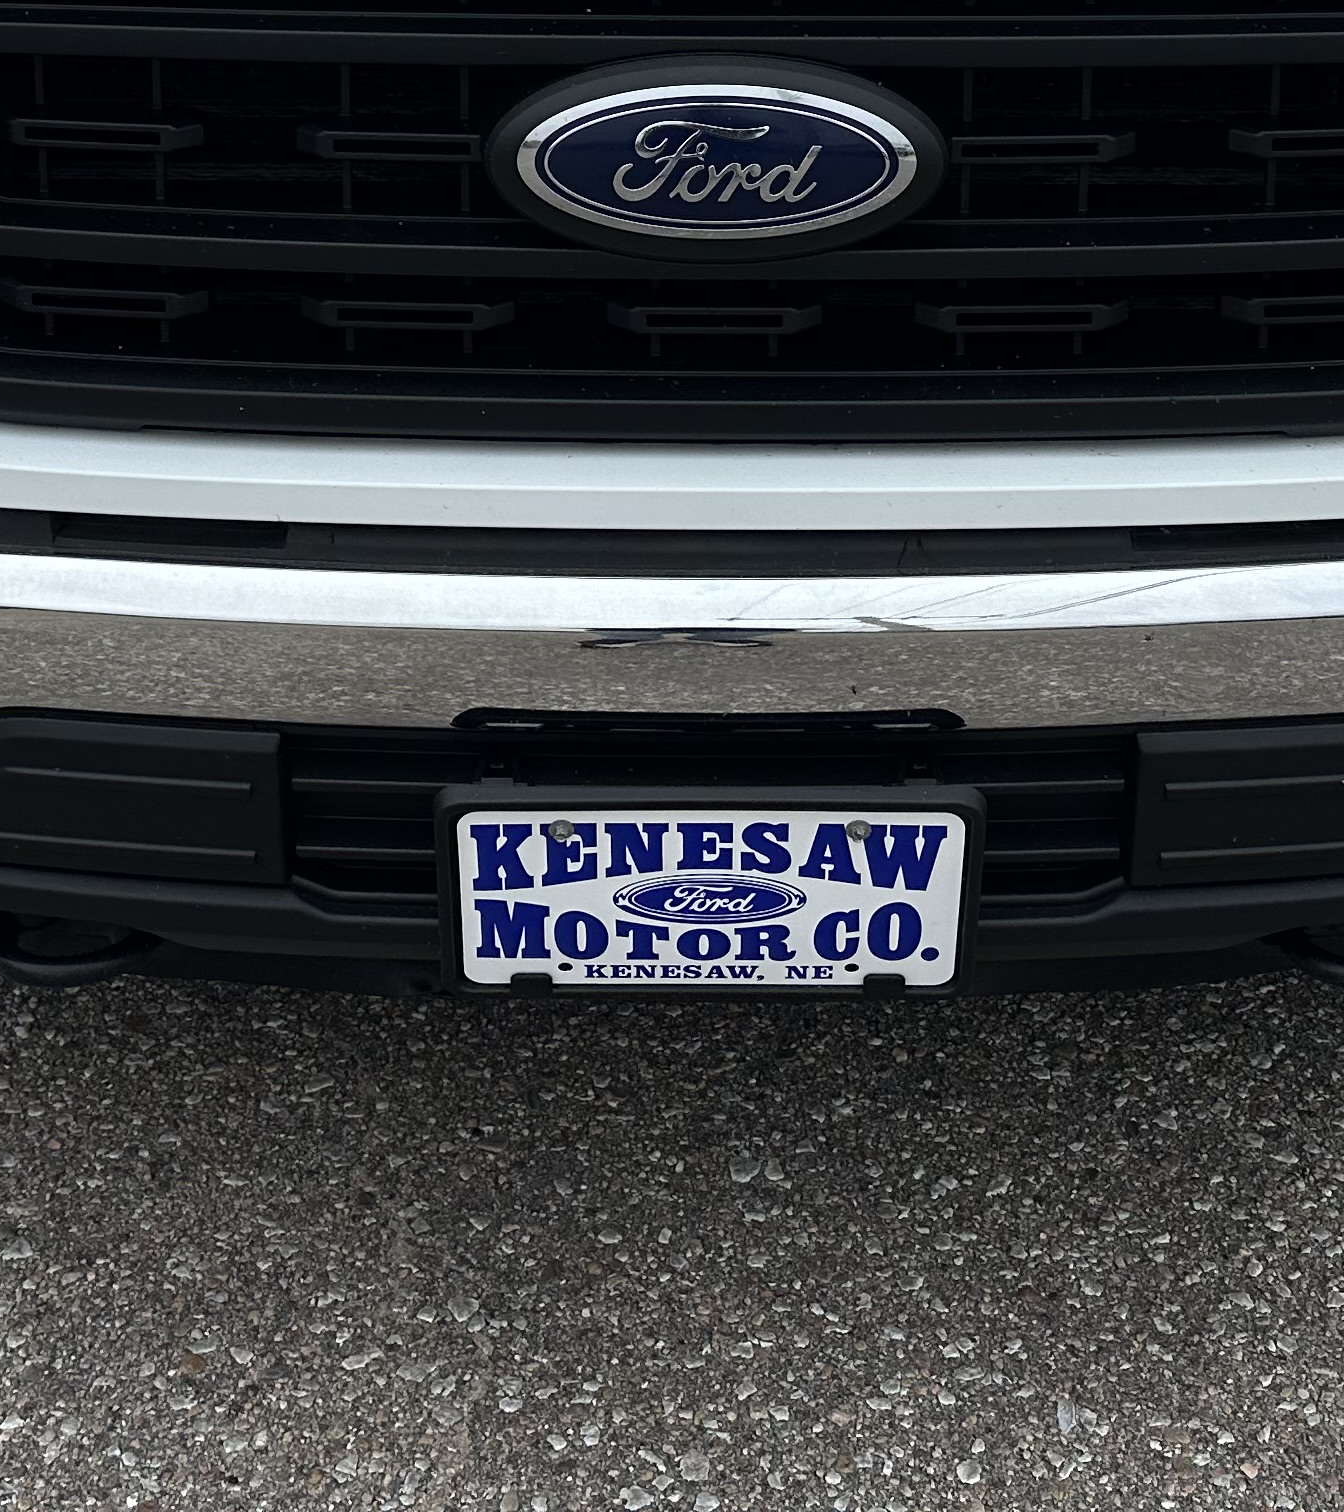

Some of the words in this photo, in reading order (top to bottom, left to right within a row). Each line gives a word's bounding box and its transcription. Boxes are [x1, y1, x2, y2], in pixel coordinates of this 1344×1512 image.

[611, 119, 823, 204] Ford
[468, 820, 948, 892] KENESAW
[474, 898, 797, 962] MOTOR
[813, 901, 940, 963] CO.
[663, 884, 757, 914] Ford
[585, 963, 766, 981] KENESAW,
[785, 964, 835, 980] NE
